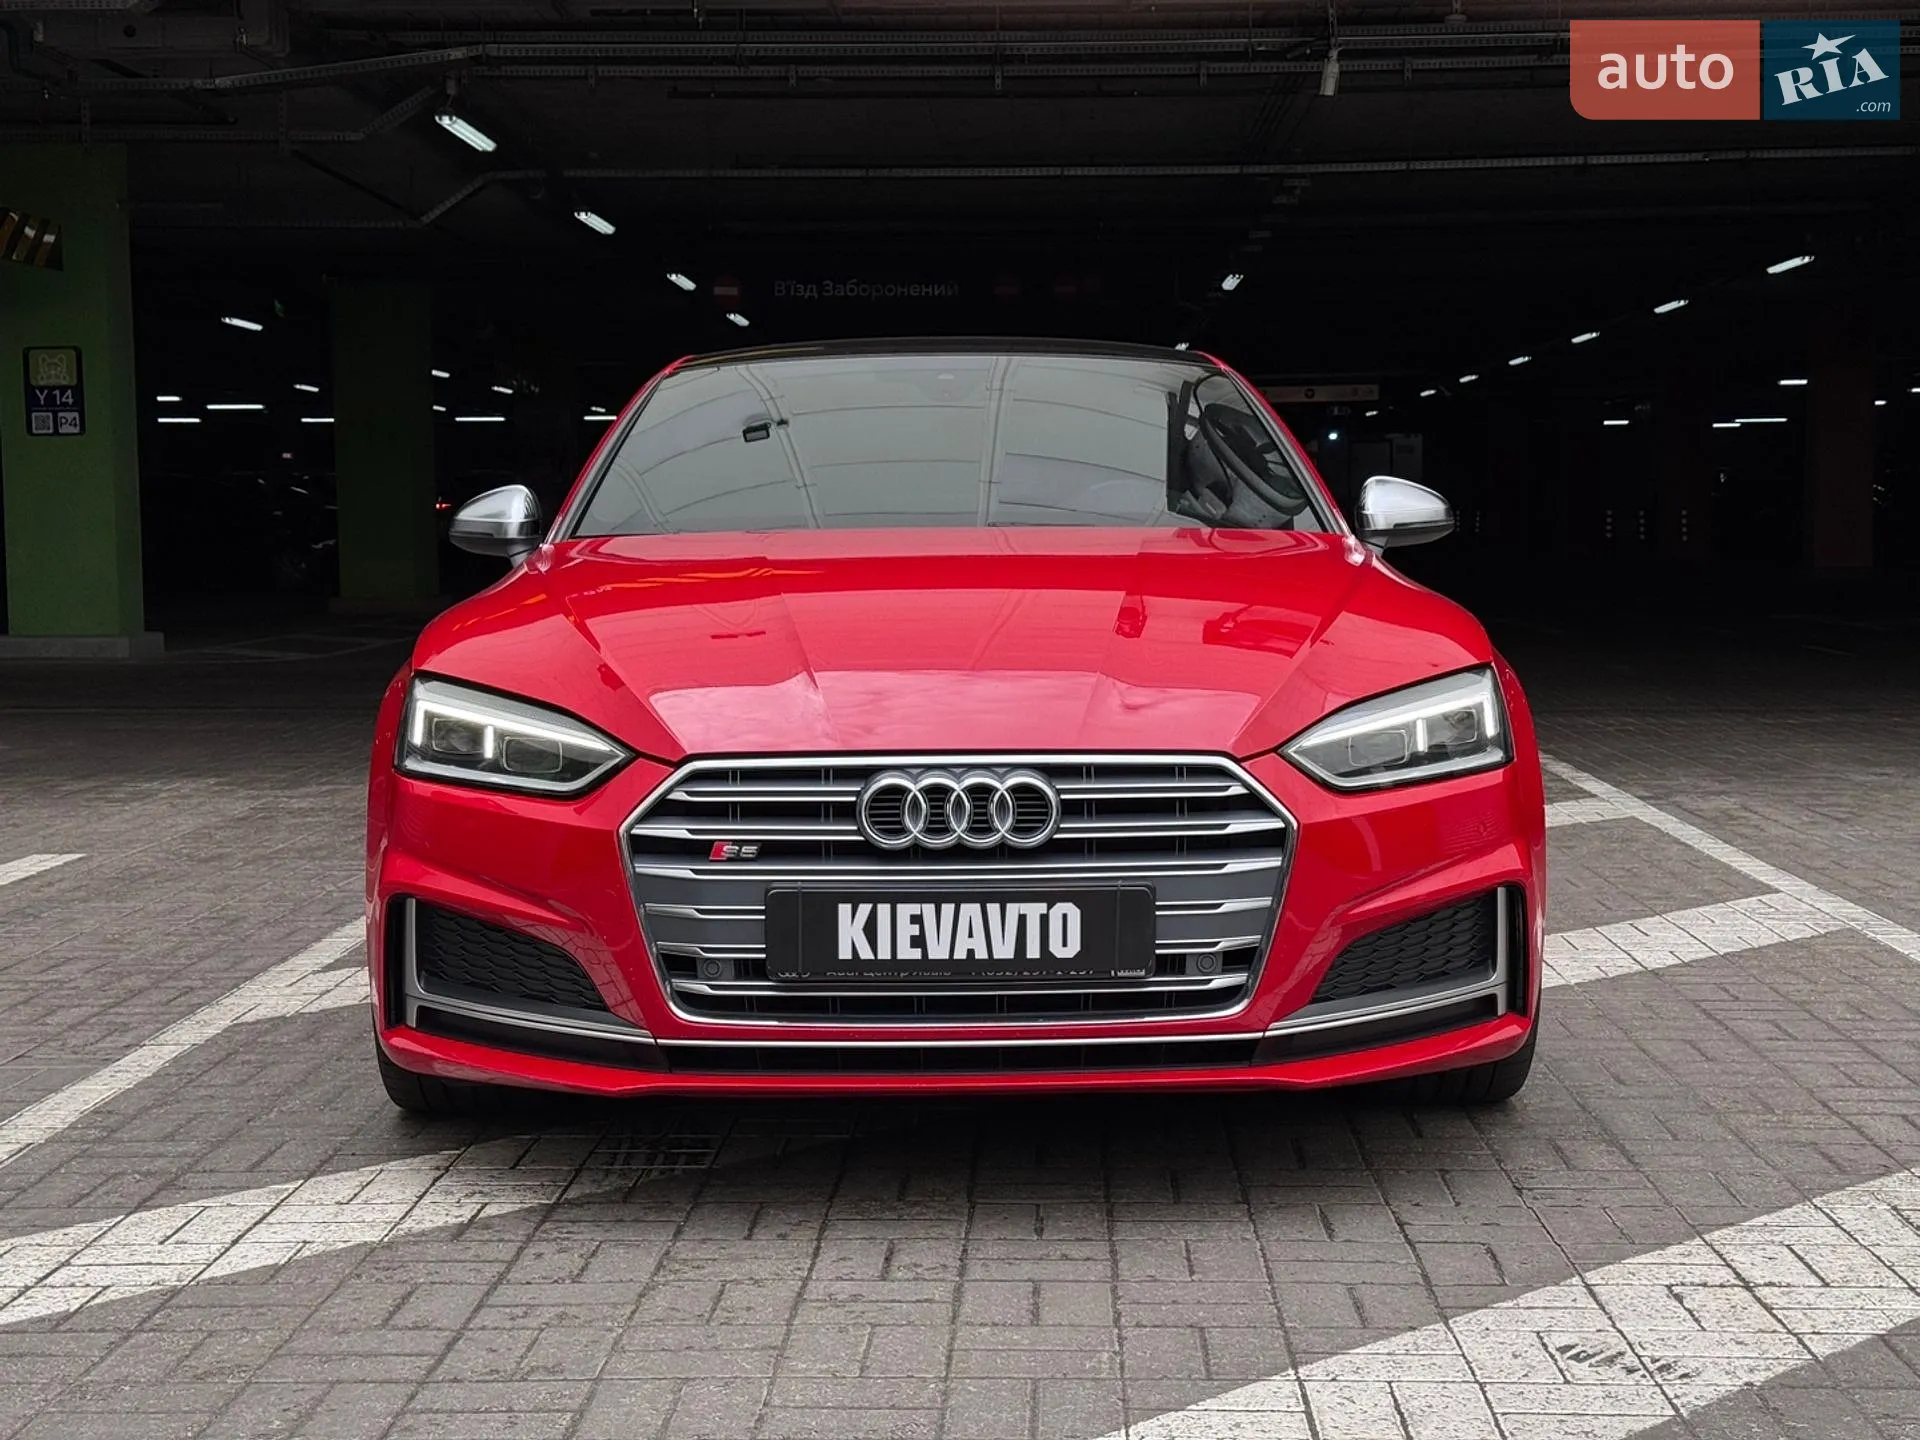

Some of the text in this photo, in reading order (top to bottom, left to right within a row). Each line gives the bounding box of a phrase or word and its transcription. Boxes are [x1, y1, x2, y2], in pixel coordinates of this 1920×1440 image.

[822, 277, 959, 302] Заборонений
[35, 389, 74, 406] Y 14
[60, 415, 78, 430] P4
[722, 845, 759, 858] S5
[837, 902, 1081, 960] KIEVAVTO
